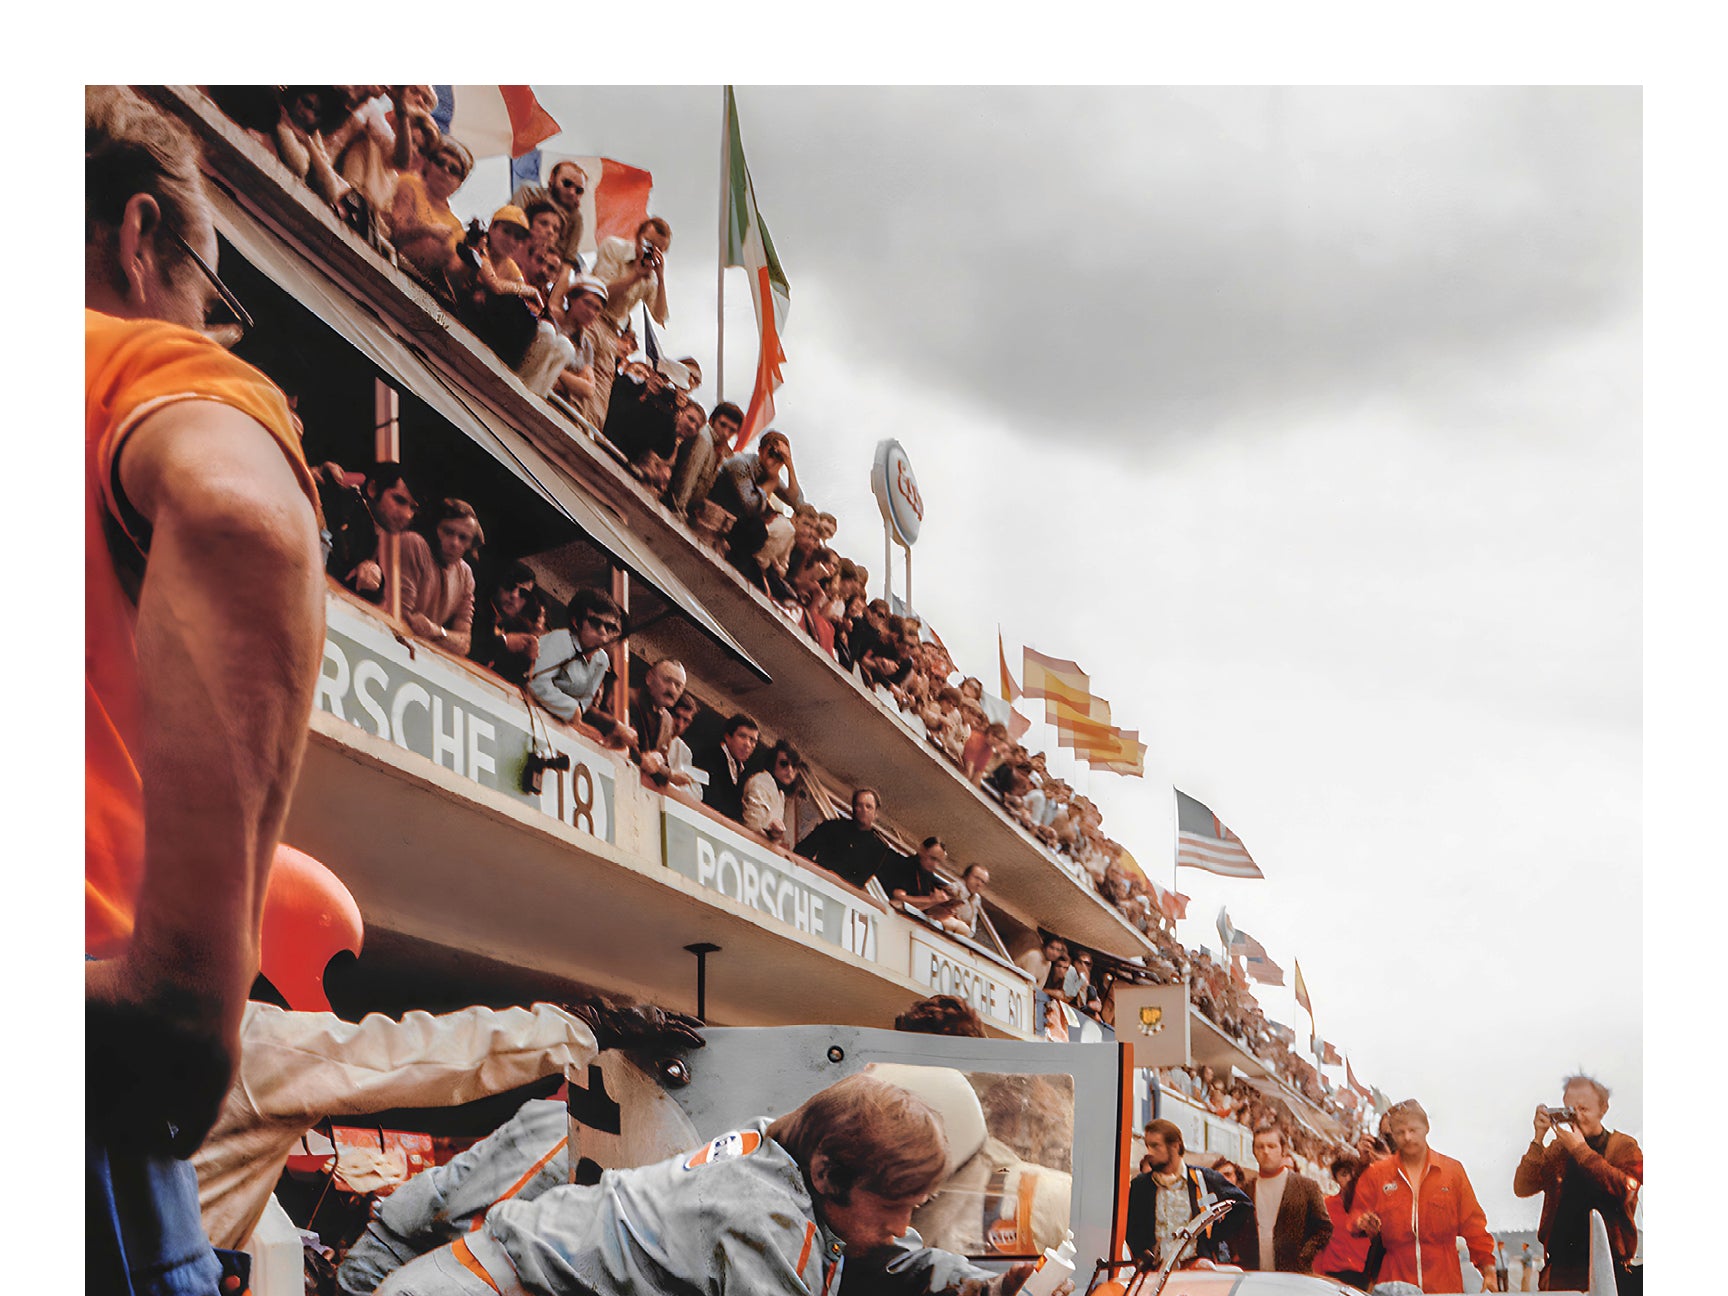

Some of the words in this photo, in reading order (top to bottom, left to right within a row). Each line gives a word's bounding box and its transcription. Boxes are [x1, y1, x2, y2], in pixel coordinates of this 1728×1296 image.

[316, 638, 496, 785] RSCHE
[697, 836, 824, 936] PORSCHE
[851, 908, 868, 958] 17
[930, 952, 996, 1016] PORSCHE
